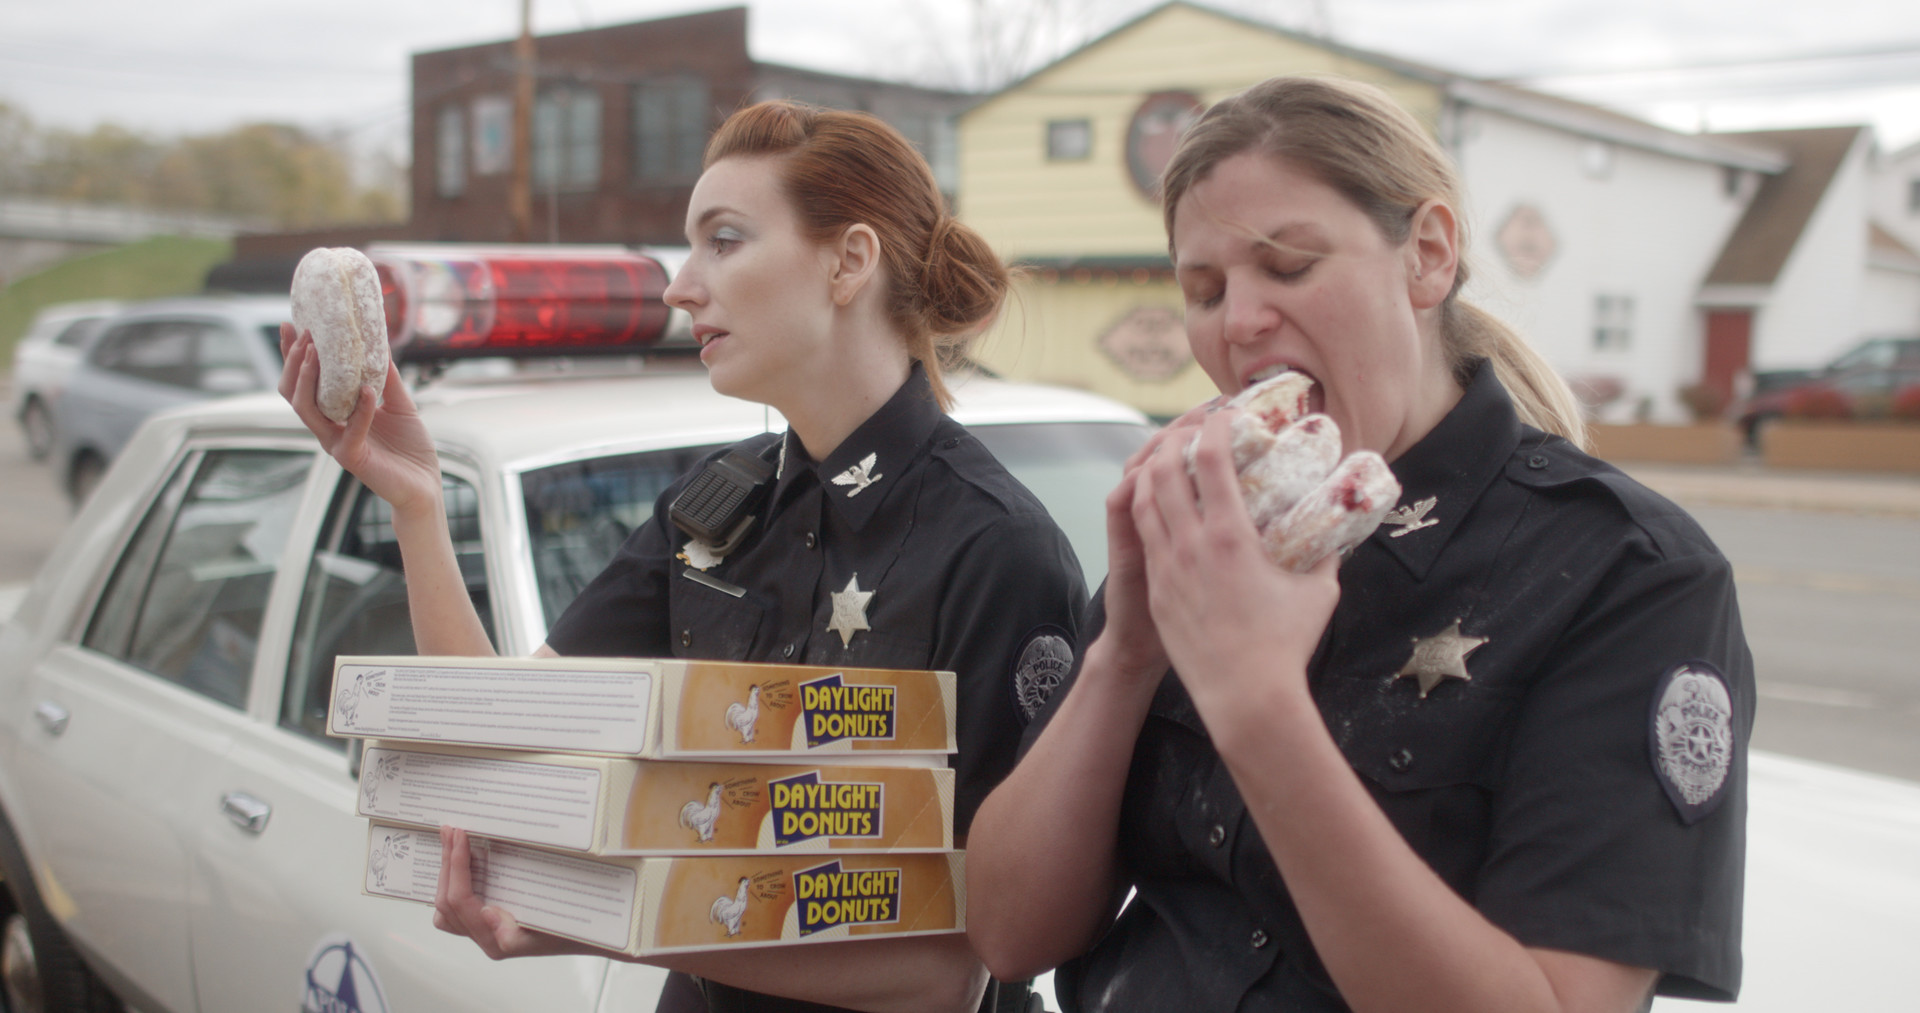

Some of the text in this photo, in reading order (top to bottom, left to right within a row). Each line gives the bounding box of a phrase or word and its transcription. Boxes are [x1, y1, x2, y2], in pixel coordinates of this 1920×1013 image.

[1033, 660, 1063, 674] POLICE
[805, 686, 893, 712] DAYLIGHT
[813, 713, 887, 737] DONUTS
[1681, 704, 1719, 725] POLICE
[774, 784, 879, 809] DAYLIGHT
[783, 812, 871, 835] DONUTS
[800, 872, 898, 899] DAYLIGHT
[806, 898, 890, 925] DONUTS
